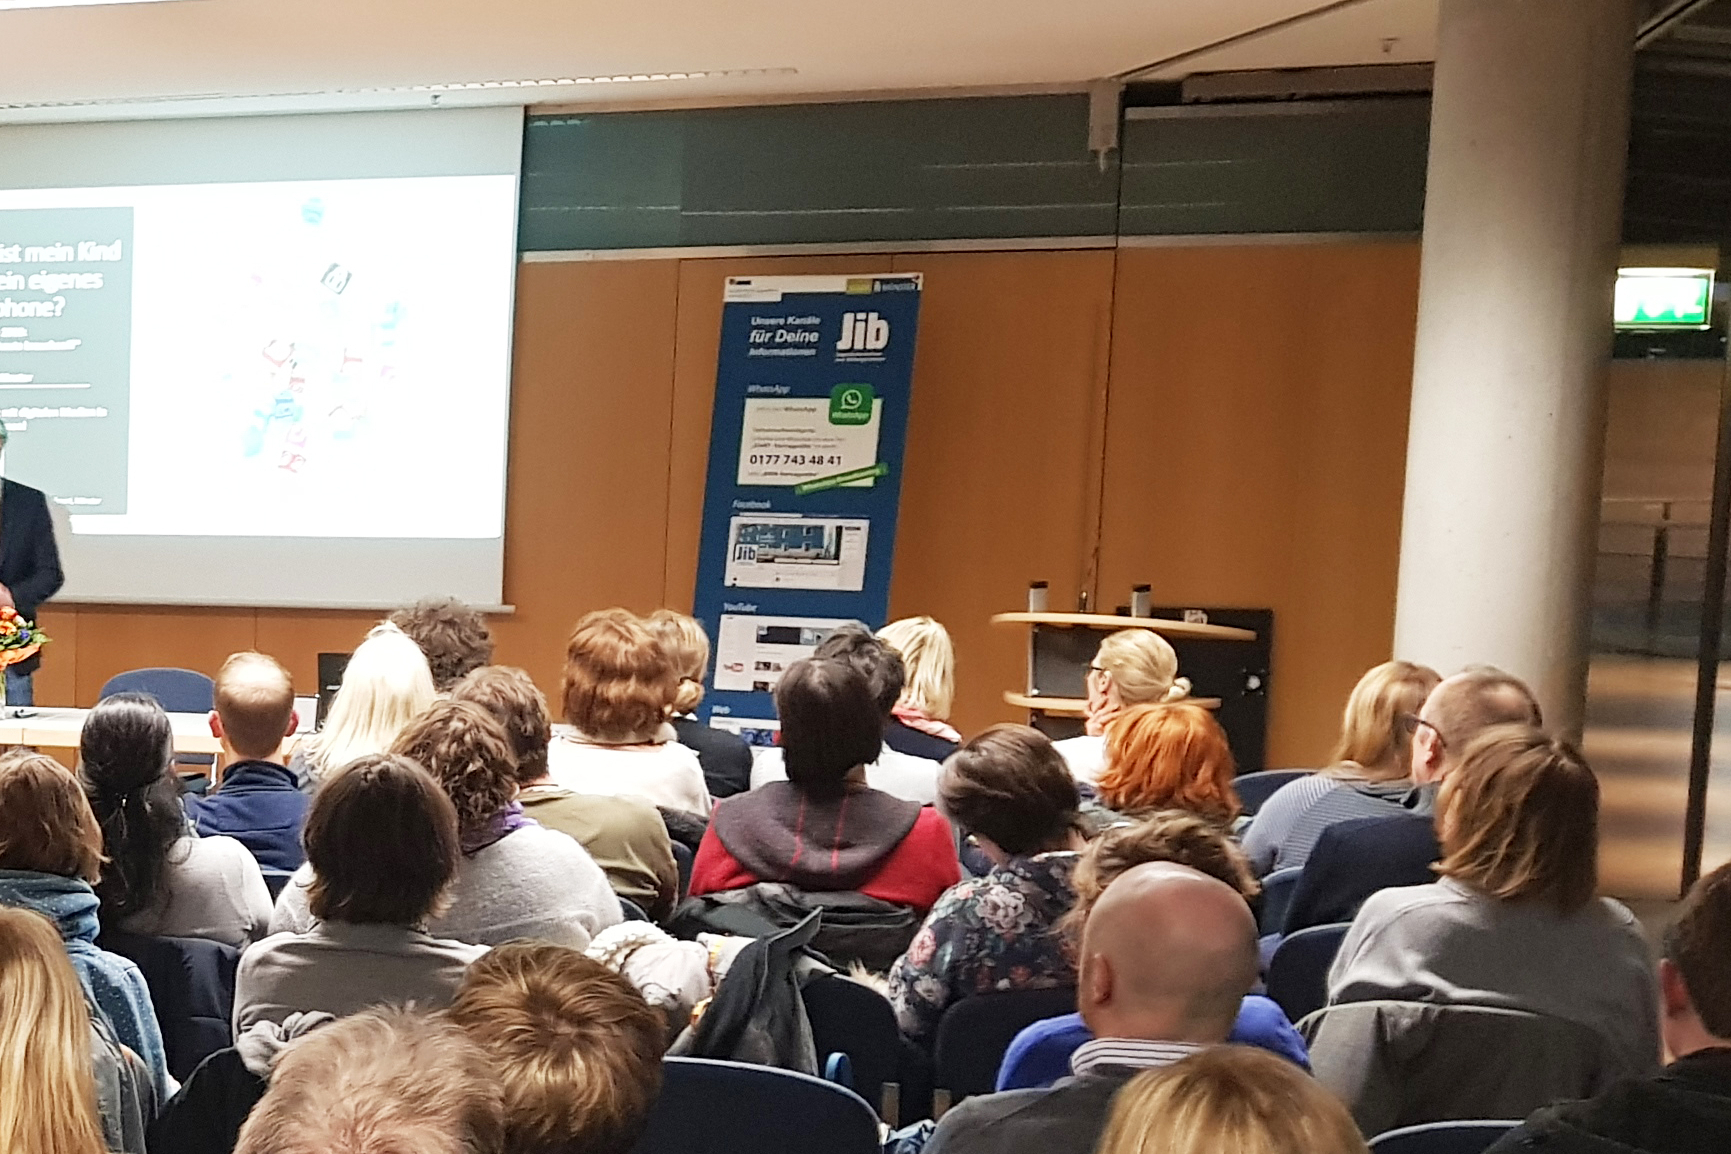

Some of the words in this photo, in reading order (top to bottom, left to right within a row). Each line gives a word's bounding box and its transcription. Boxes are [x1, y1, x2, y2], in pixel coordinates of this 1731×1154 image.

[25, 242, 74, 262] mein
[78, 239, 122, 262] Kind
[27, 270, 104, 294] eigenes
[749, 329, 771, 344] für
[774, 329, 819, 343] Deine
[747, 384, 790, 396] WhatsApp
[749, 455, 780, 466] 0177
[784, 455, 806, 466] 743
[809, 455, 824, 466] 48
[827, 455, 842, 466] 41
[732, 499, 771, 510] Facebook
[736, 546, 757, 561] Jib
[723, 602, 758, 612] YouTube
